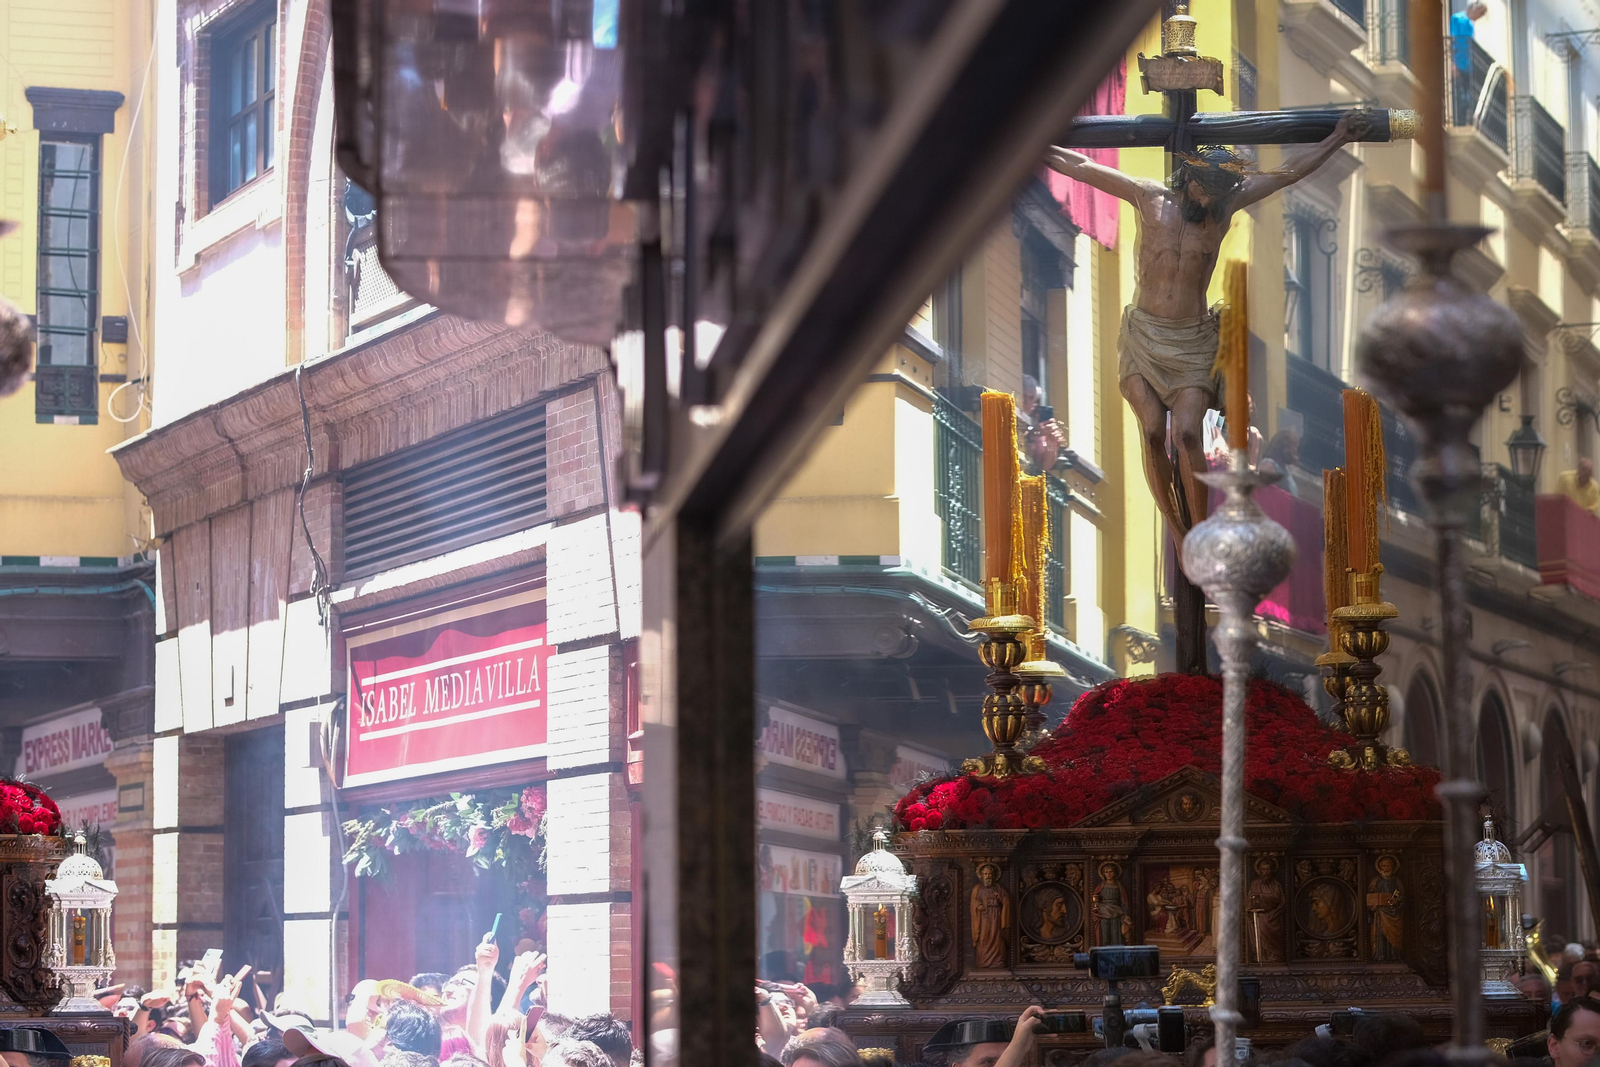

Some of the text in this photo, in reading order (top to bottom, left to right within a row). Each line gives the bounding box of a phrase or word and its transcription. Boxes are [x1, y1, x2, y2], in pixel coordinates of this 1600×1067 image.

[360, 654, 541, 727] ISABEL MEDIAVILLA
[24, 720, 112, 773] EXPRESS MARKE
